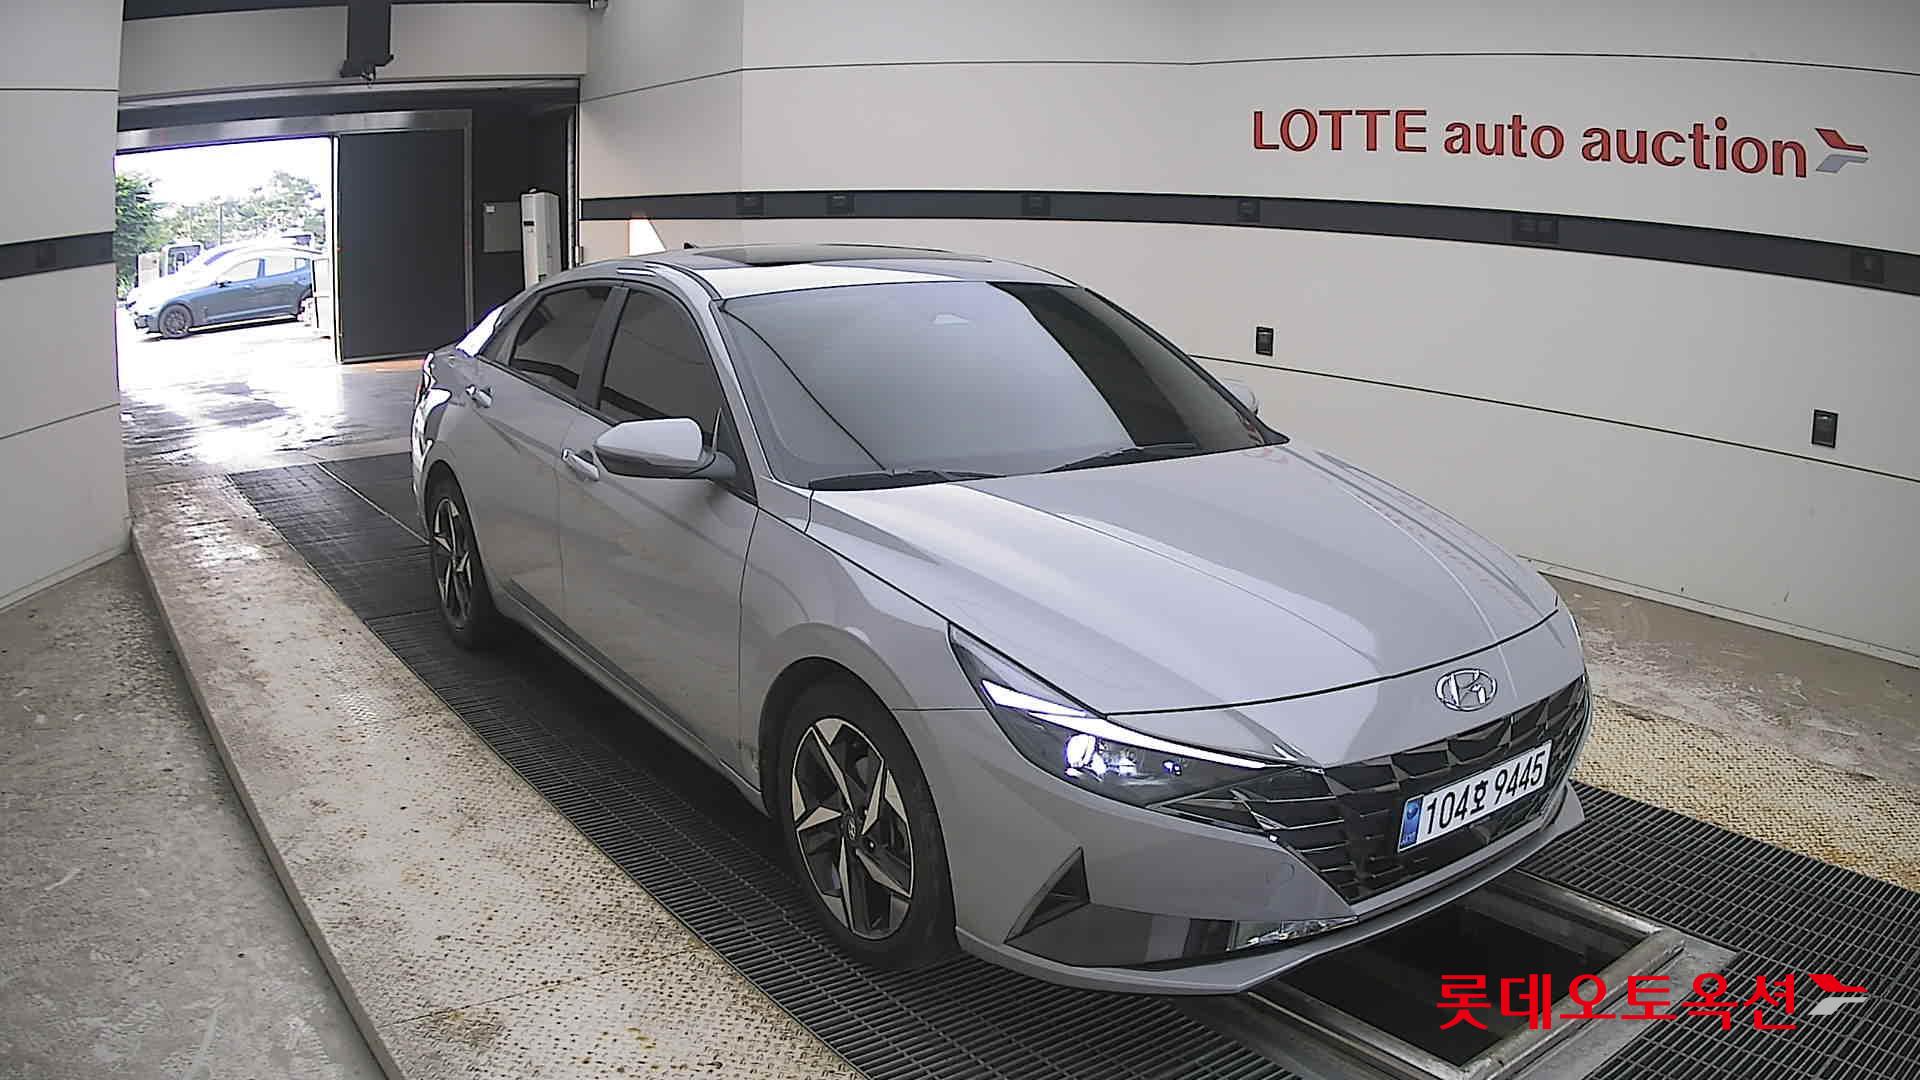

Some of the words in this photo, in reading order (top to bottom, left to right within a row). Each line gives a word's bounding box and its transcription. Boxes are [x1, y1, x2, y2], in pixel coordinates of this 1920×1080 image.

[1253, 109, 1427, 152] LOTTE
[1443, 114, 1564, 159] auto
[1581, 116, 1807, 178] auction
[1427, 779, 1488, 834] 104호
[1494, 750, 1546, 805] 9445
